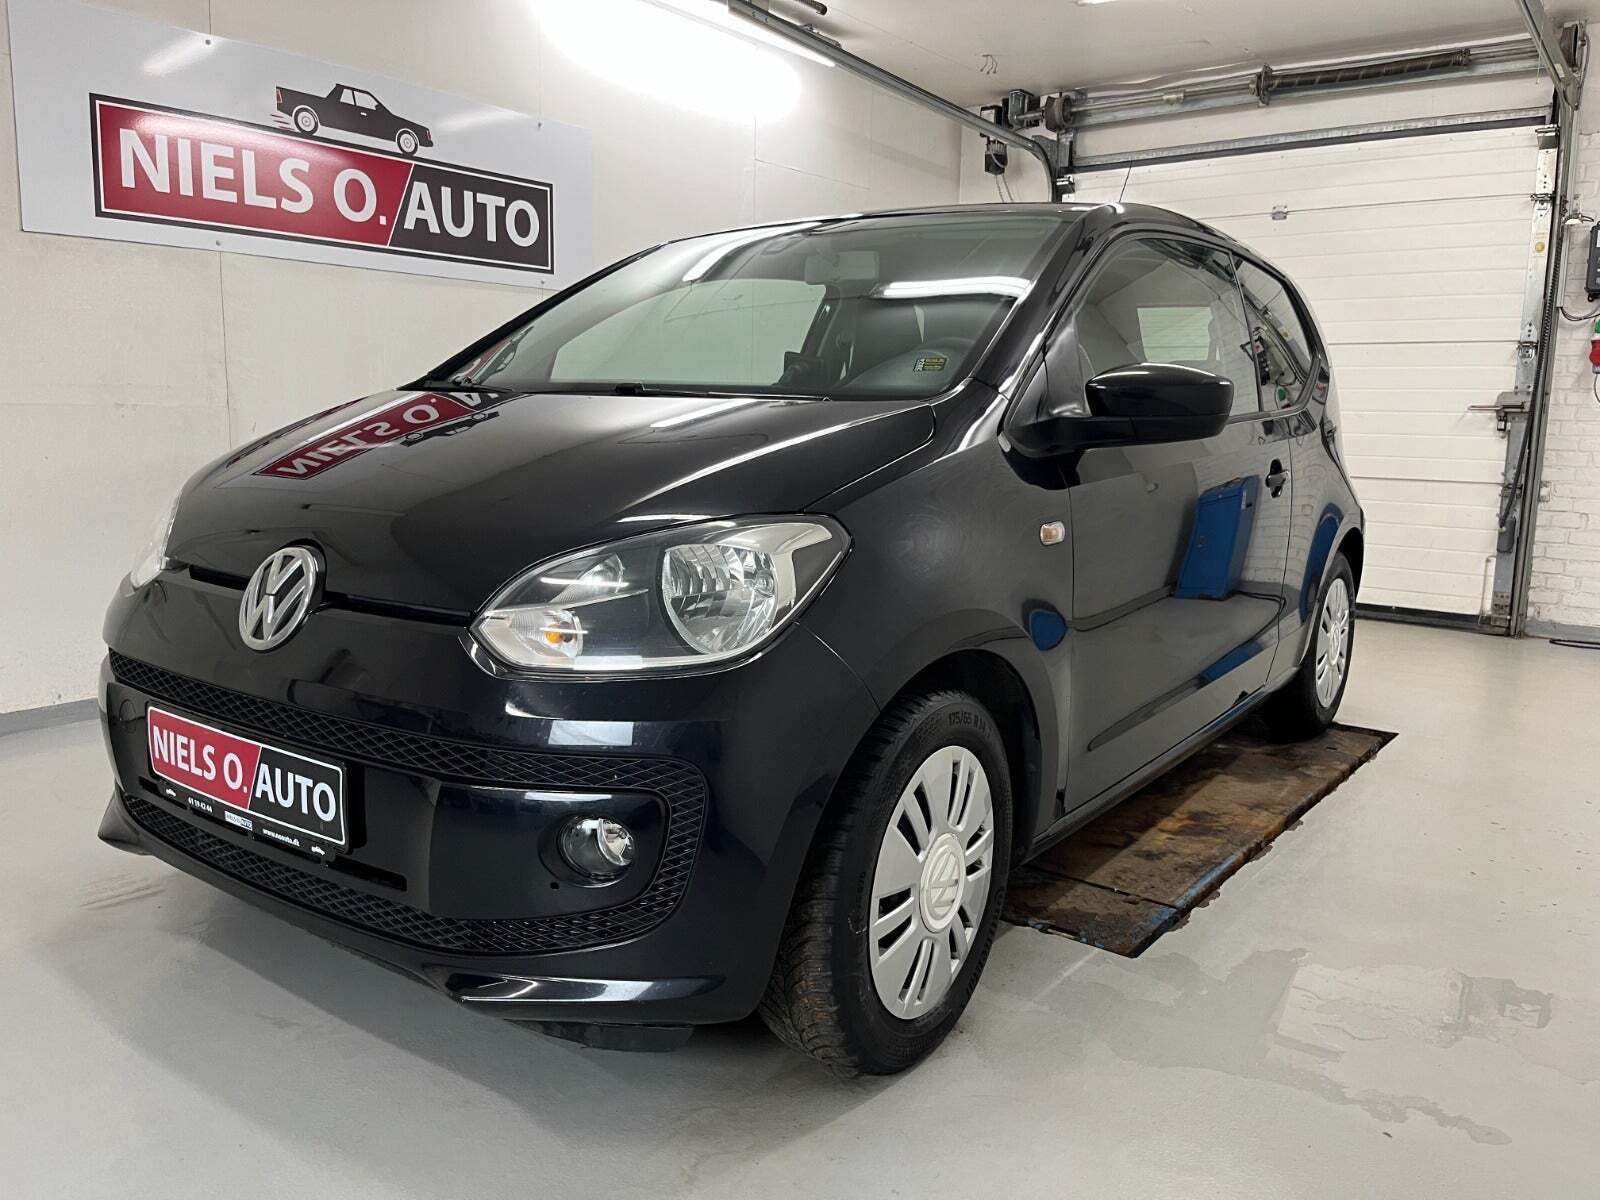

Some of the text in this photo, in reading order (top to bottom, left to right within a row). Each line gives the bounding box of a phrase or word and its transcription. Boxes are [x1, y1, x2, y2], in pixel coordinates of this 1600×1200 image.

[119, 128, 540, 248] NIELS O. AUTO
[153, 725, 337, 822] NIELS O. AUTO
